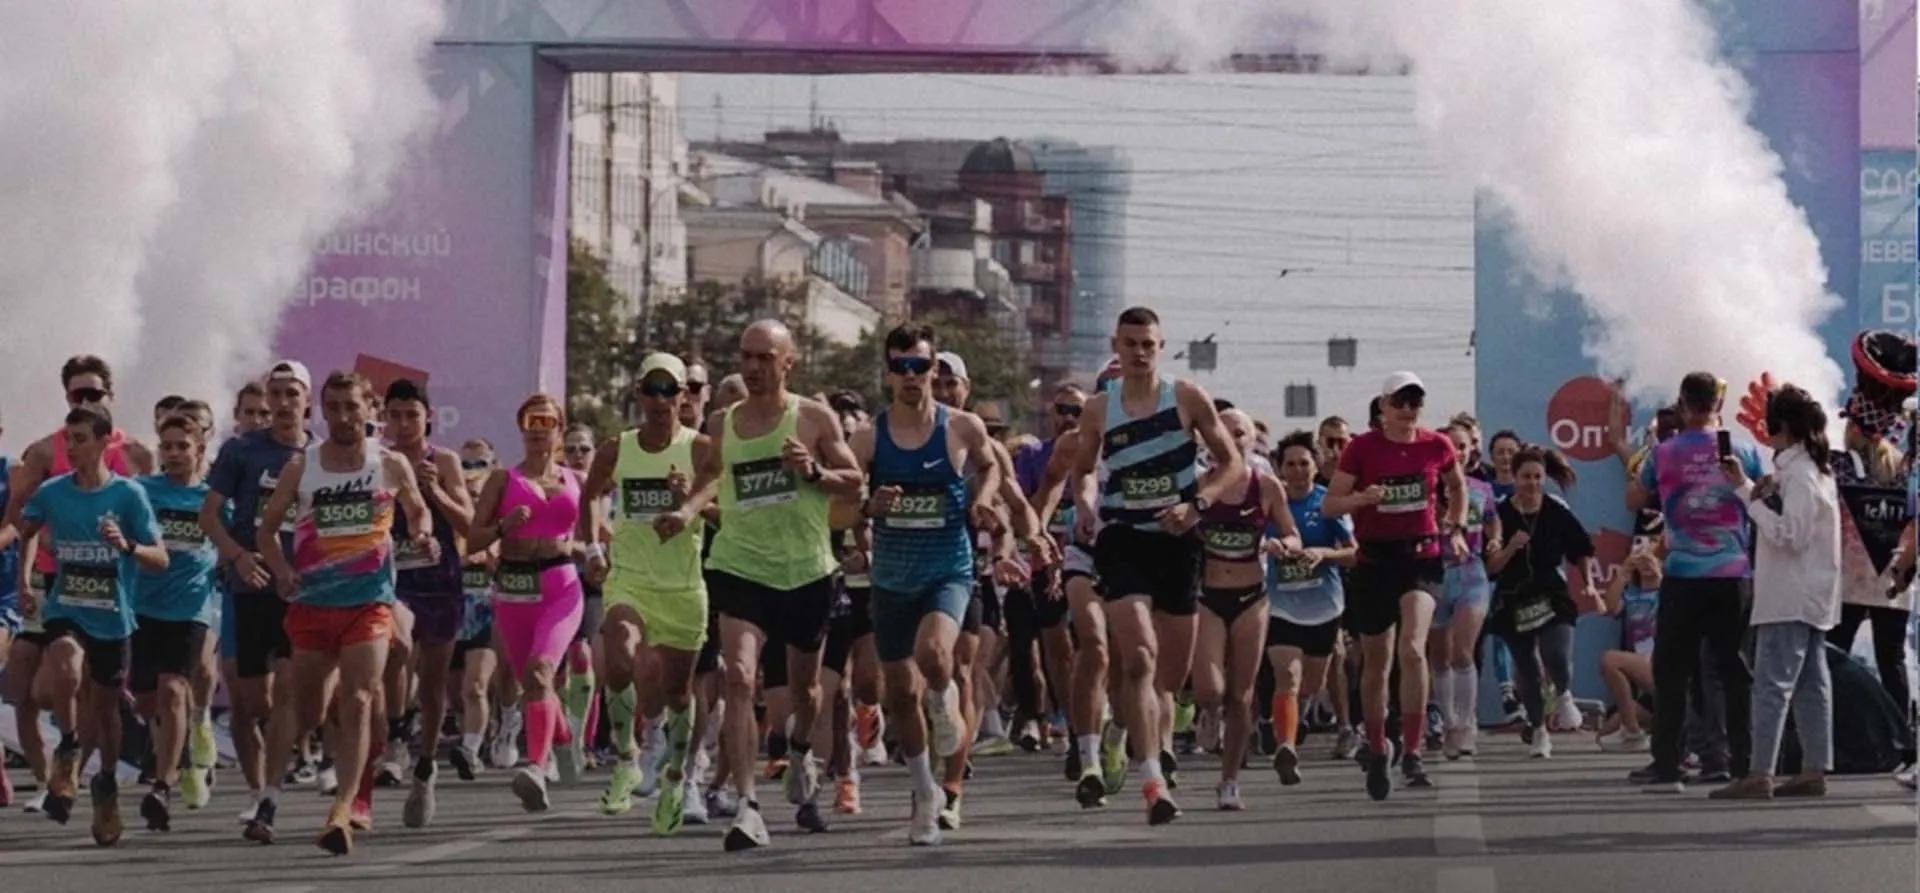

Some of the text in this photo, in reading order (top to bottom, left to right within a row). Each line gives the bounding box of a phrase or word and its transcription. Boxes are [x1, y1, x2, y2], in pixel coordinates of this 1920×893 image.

[1551, 418, 1645, 449] Опи
[740, 470, 788, 493] 3774
[1126, 476, 1173, 495] 3299
[629, 489, 674, 507] 3188
[1385, 484, 1421, 501] 3138
[320, 502, 370, 524] 3506
[1209, 532, 1253, 547] 4229
[65, 575, 110, 594] 3504
[501, 575, 535, 590] 4281
